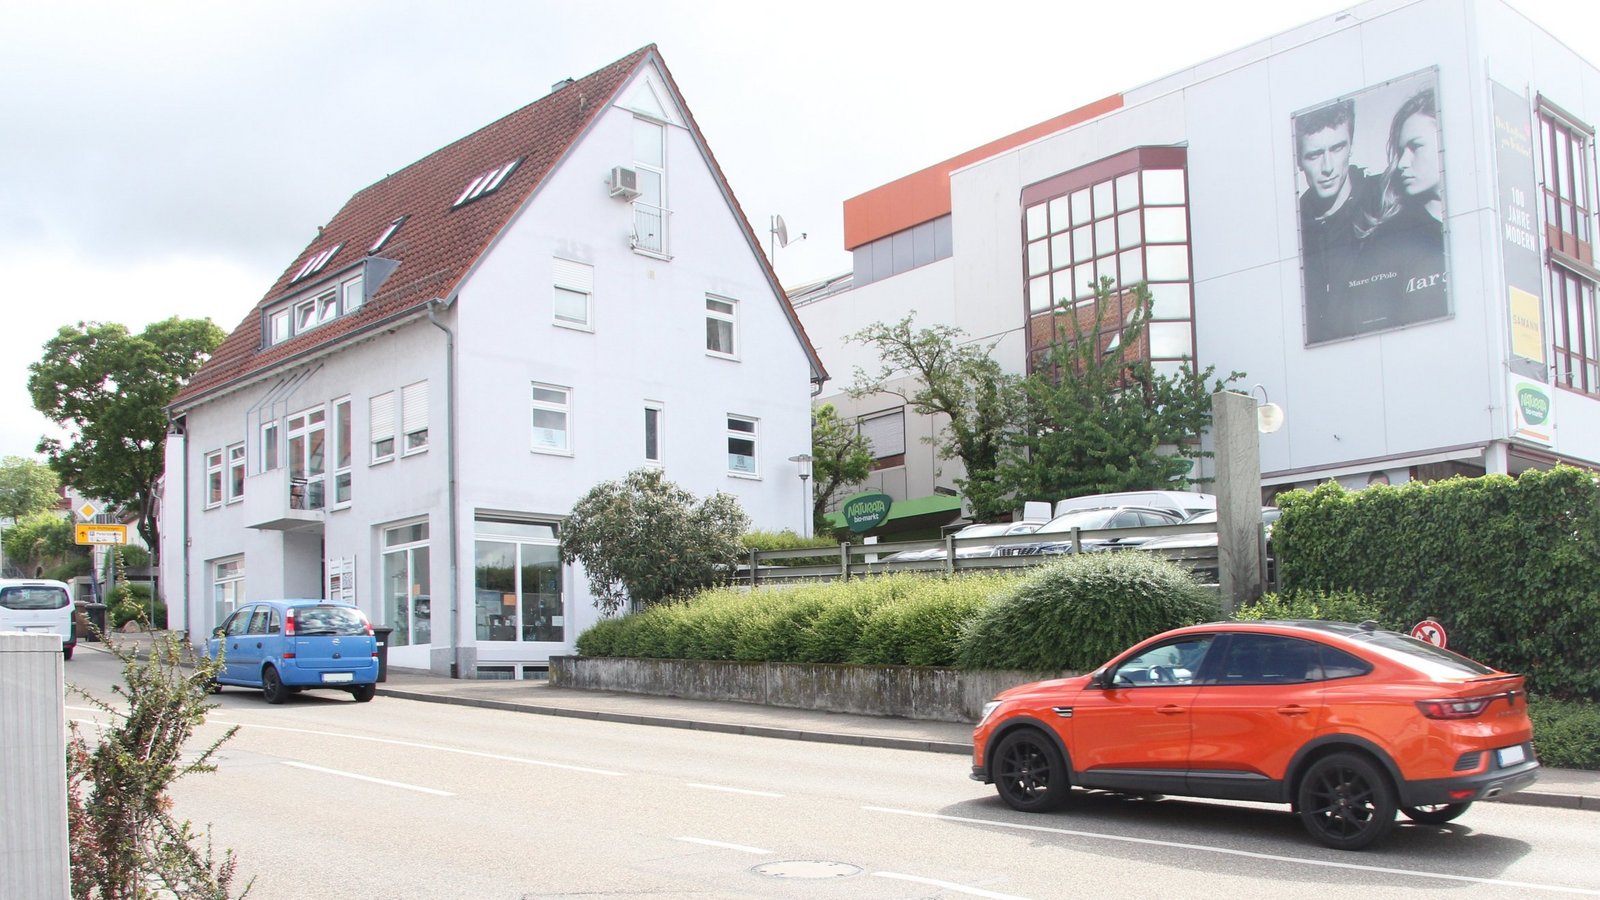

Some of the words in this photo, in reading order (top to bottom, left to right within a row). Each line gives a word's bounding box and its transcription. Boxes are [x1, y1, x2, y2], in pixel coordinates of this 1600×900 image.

[1508, 205, 1530, 230] JAHRE
[1505, 223, 1535, 252] MODERN
[1348, 278, 1369, 288] Marc
[1371, 271, 1398, 282] O'Polo
[848, 500, 885, 518] NATURATA
[854, 513, 880, 523] bio-markt
